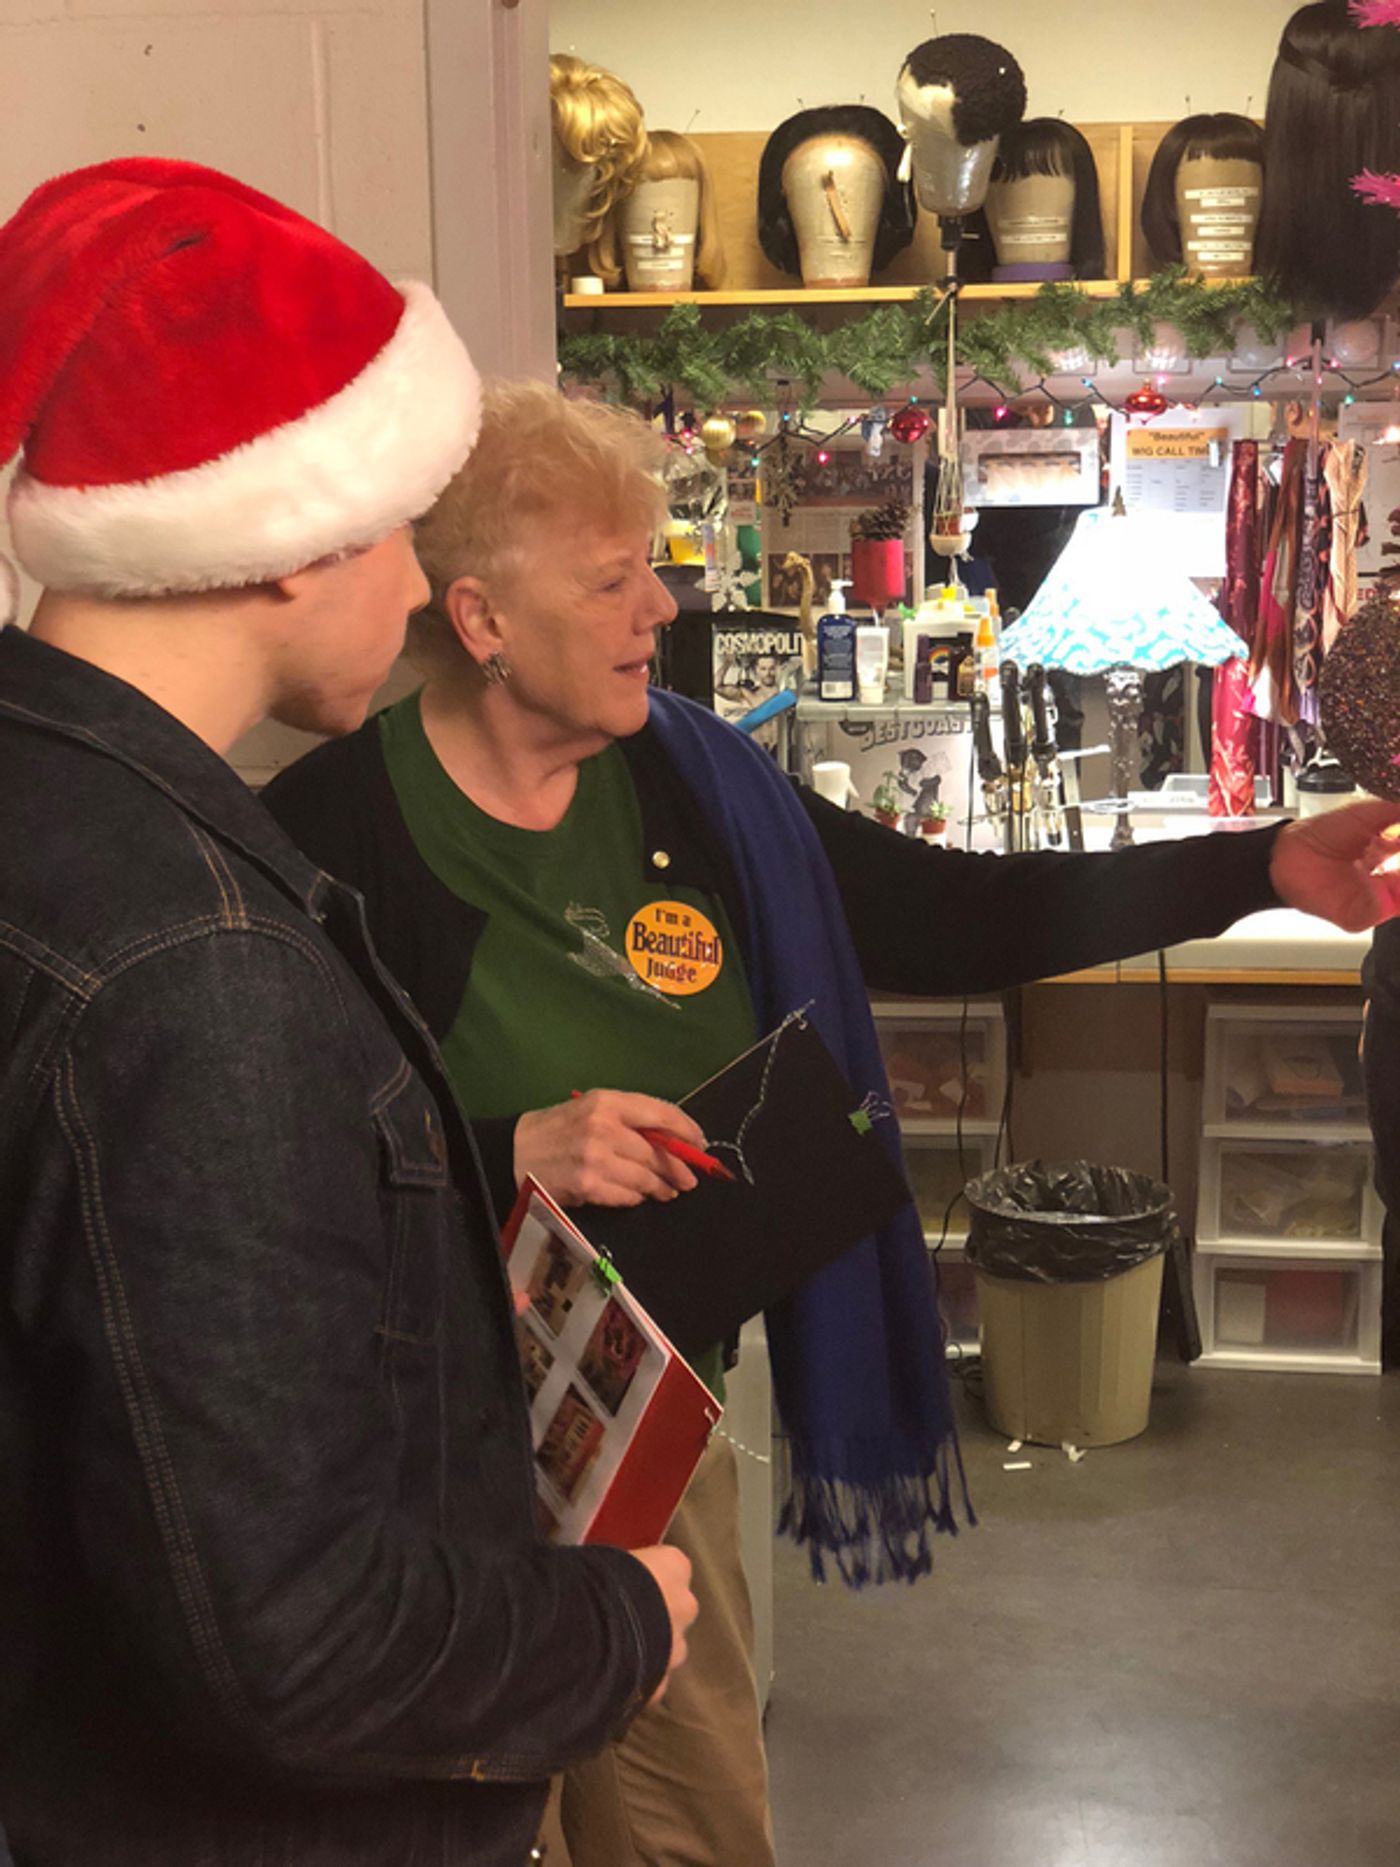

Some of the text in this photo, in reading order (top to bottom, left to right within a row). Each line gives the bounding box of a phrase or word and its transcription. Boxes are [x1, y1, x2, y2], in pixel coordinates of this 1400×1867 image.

[1149, 431, 1205, 442] "Beautiful"
[1132, 447, 1154, 457] WIG
[1155, 446, 1184, 457] CALL
[656, 908, 691, 927] I'm a
[633, 921, 720, 965] Beautiful
[647, 958, 697, 983] Judge
